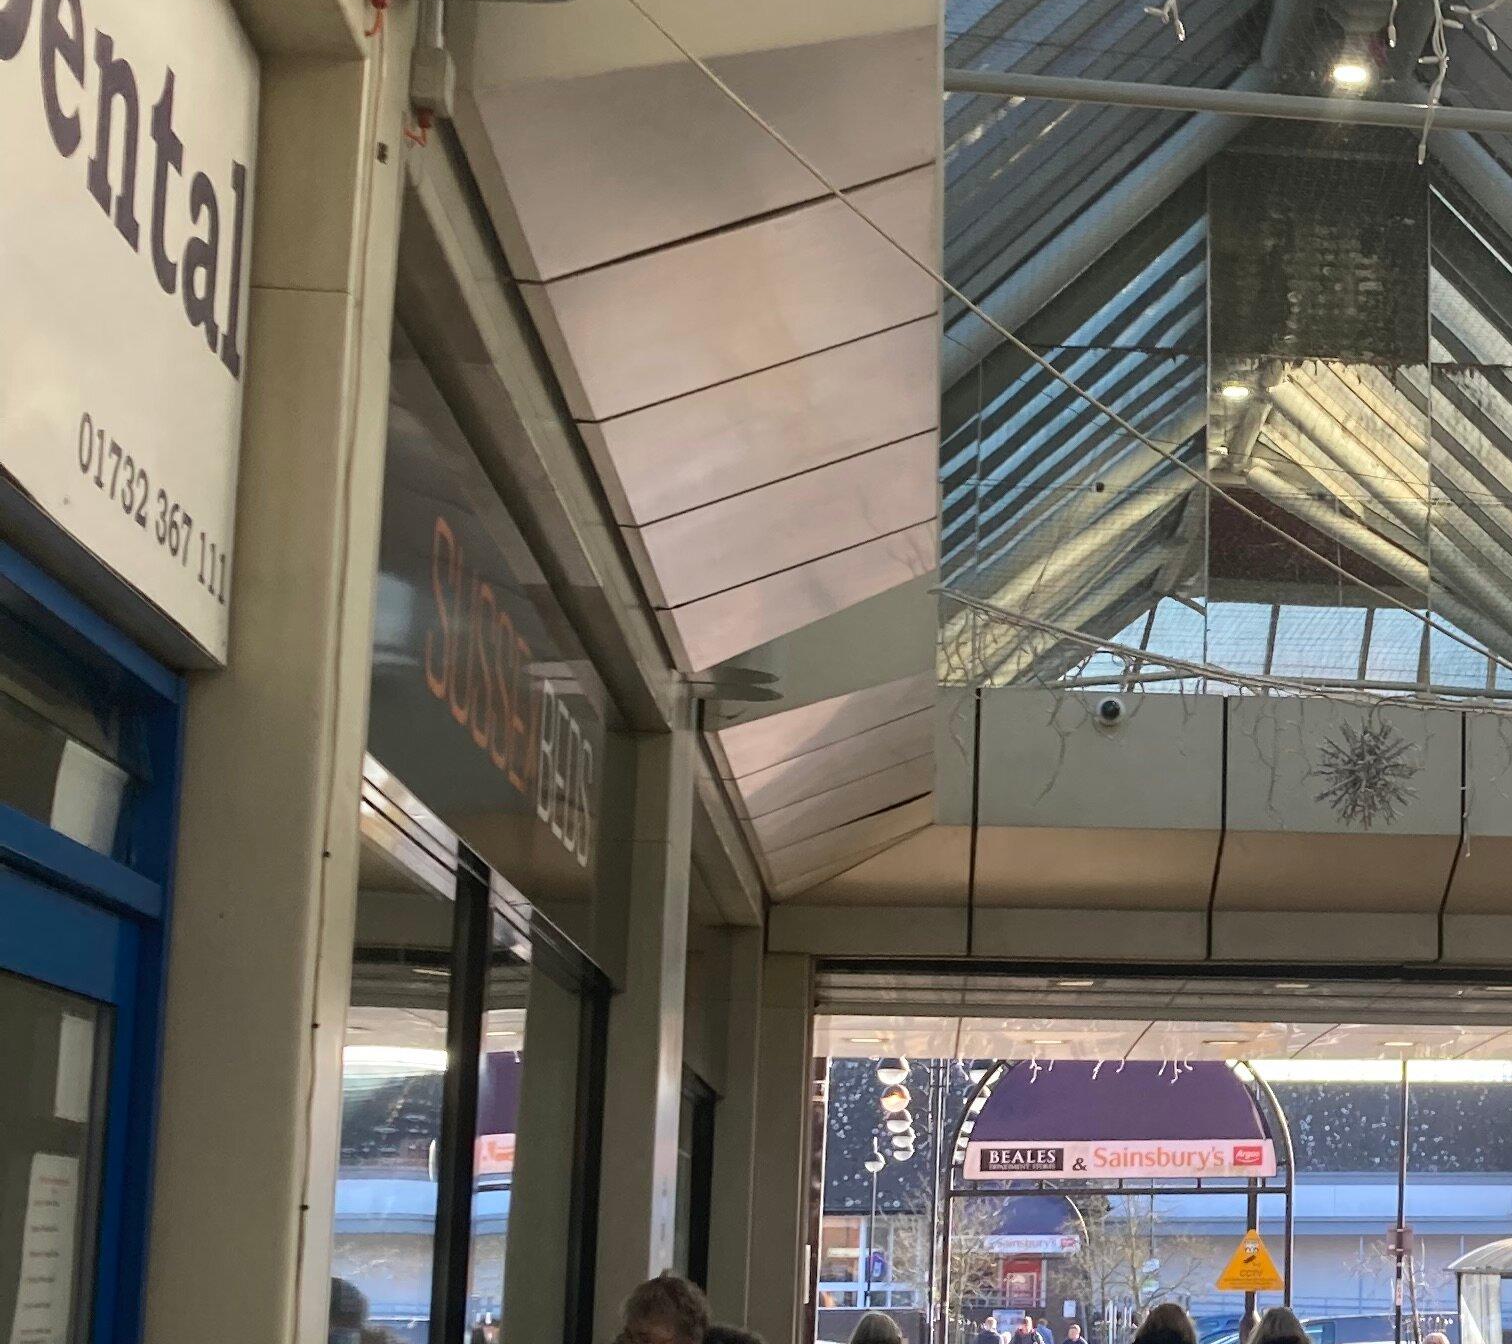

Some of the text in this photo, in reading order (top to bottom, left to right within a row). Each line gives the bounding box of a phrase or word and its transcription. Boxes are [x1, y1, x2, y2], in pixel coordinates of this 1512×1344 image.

[79, 412, 225, 604] 01732 367 111
[537, 677, 593, 867] BEDS
[989, 1149, 1056, 1164] BEALES
[1072, 1157, 1088, 1172] &
[1093, 1146, 1225, 1170] Sainsbury's
